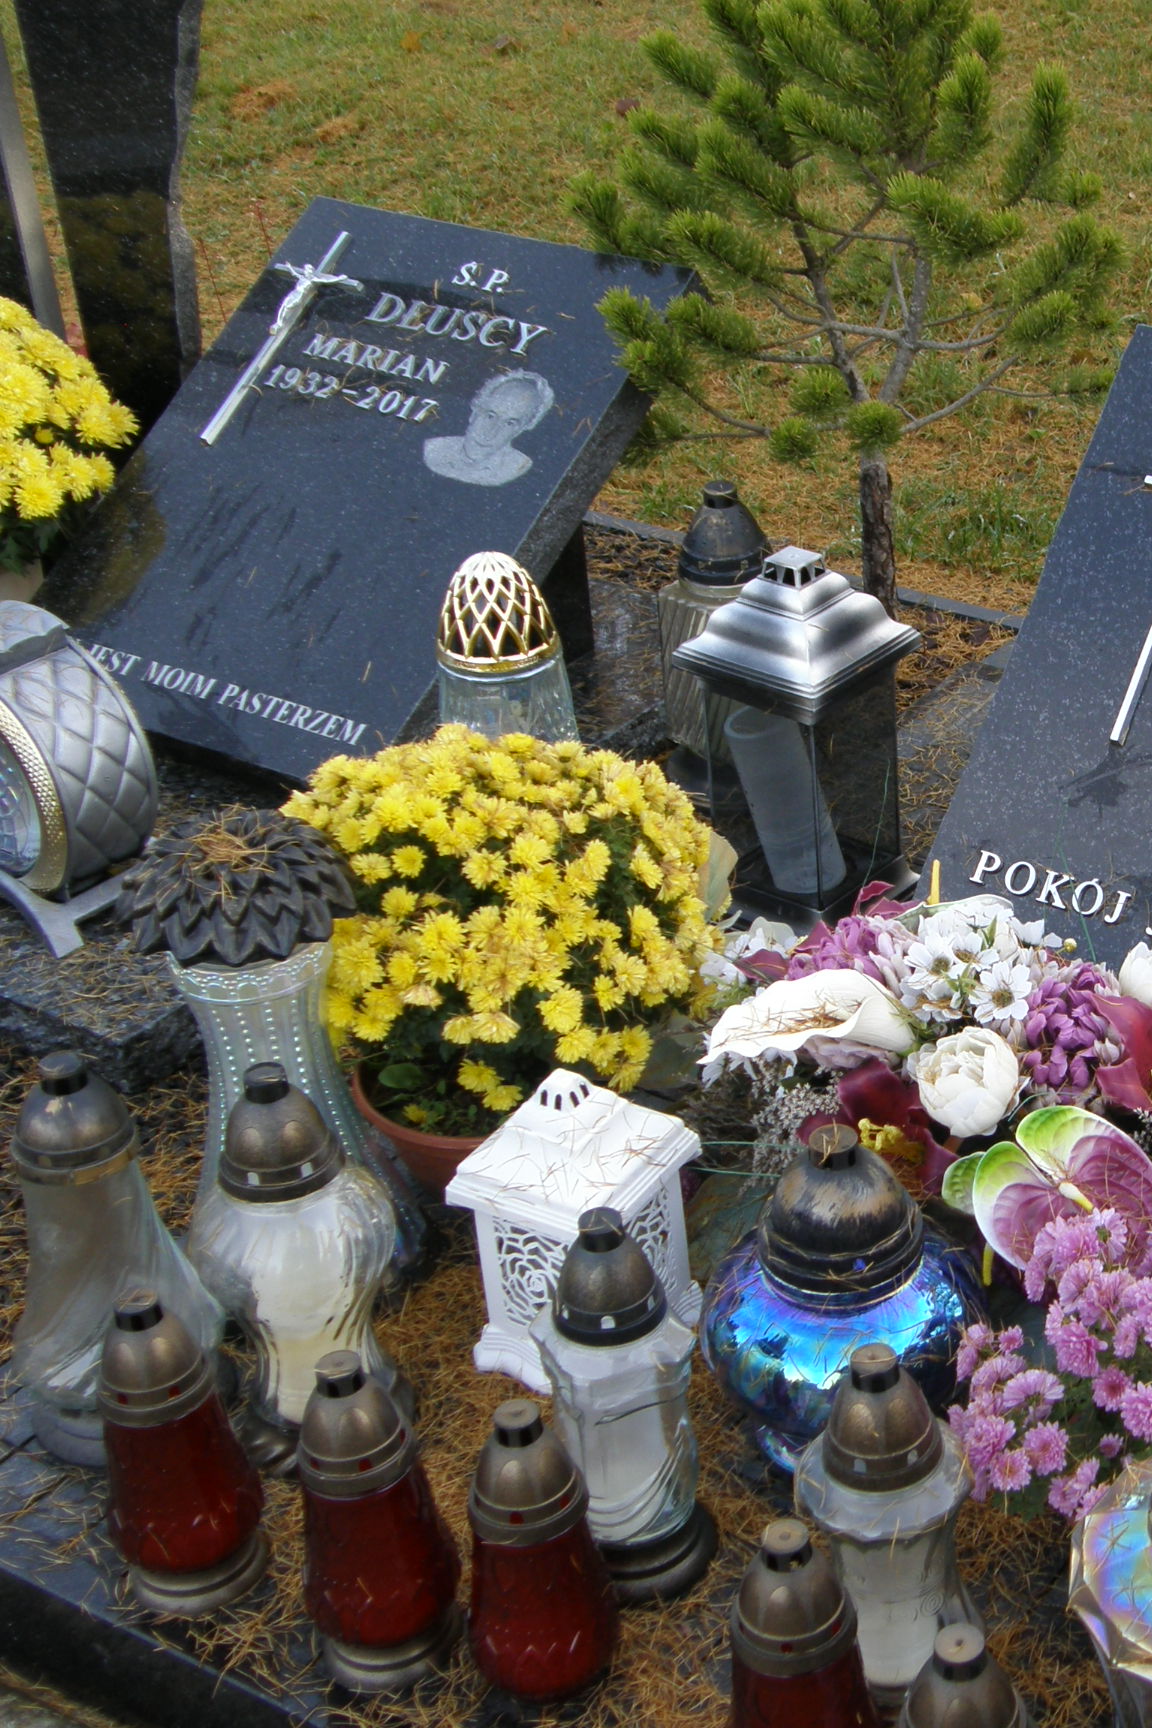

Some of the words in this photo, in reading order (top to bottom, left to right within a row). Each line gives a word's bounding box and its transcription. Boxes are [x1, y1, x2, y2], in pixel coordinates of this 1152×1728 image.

[302, 333, 450, 385] MARIAN
[140, 660, 217, 700] MOIM
[217, 683, 368, 746] PASTERZEM
[969, 850, 1133, 925] POKÓJ
